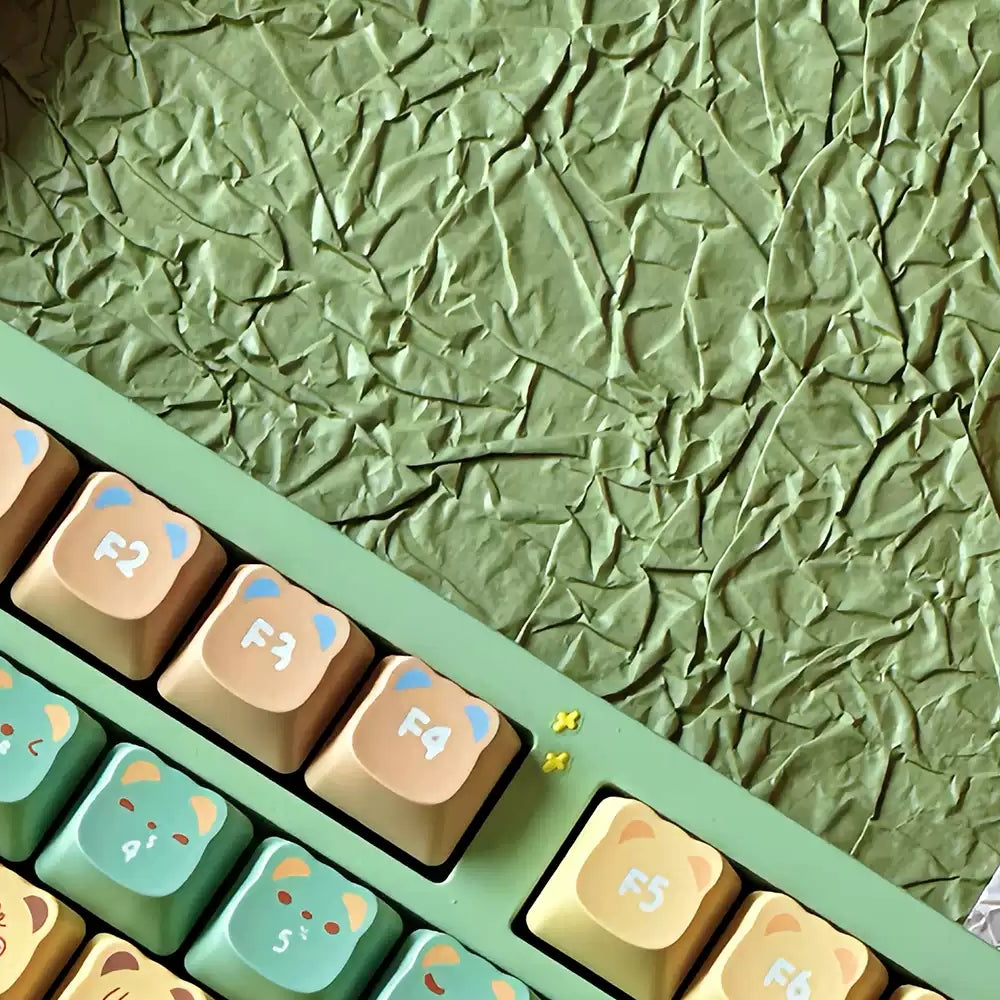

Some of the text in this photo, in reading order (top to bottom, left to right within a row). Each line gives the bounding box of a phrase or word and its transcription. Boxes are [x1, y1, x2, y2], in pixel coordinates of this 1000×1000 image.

[94, 530, 150, 578] F2
[240, 617, 296, 671] F3
[617, 867, 669, 913] F5
[272, 928, 292, 953] 5
